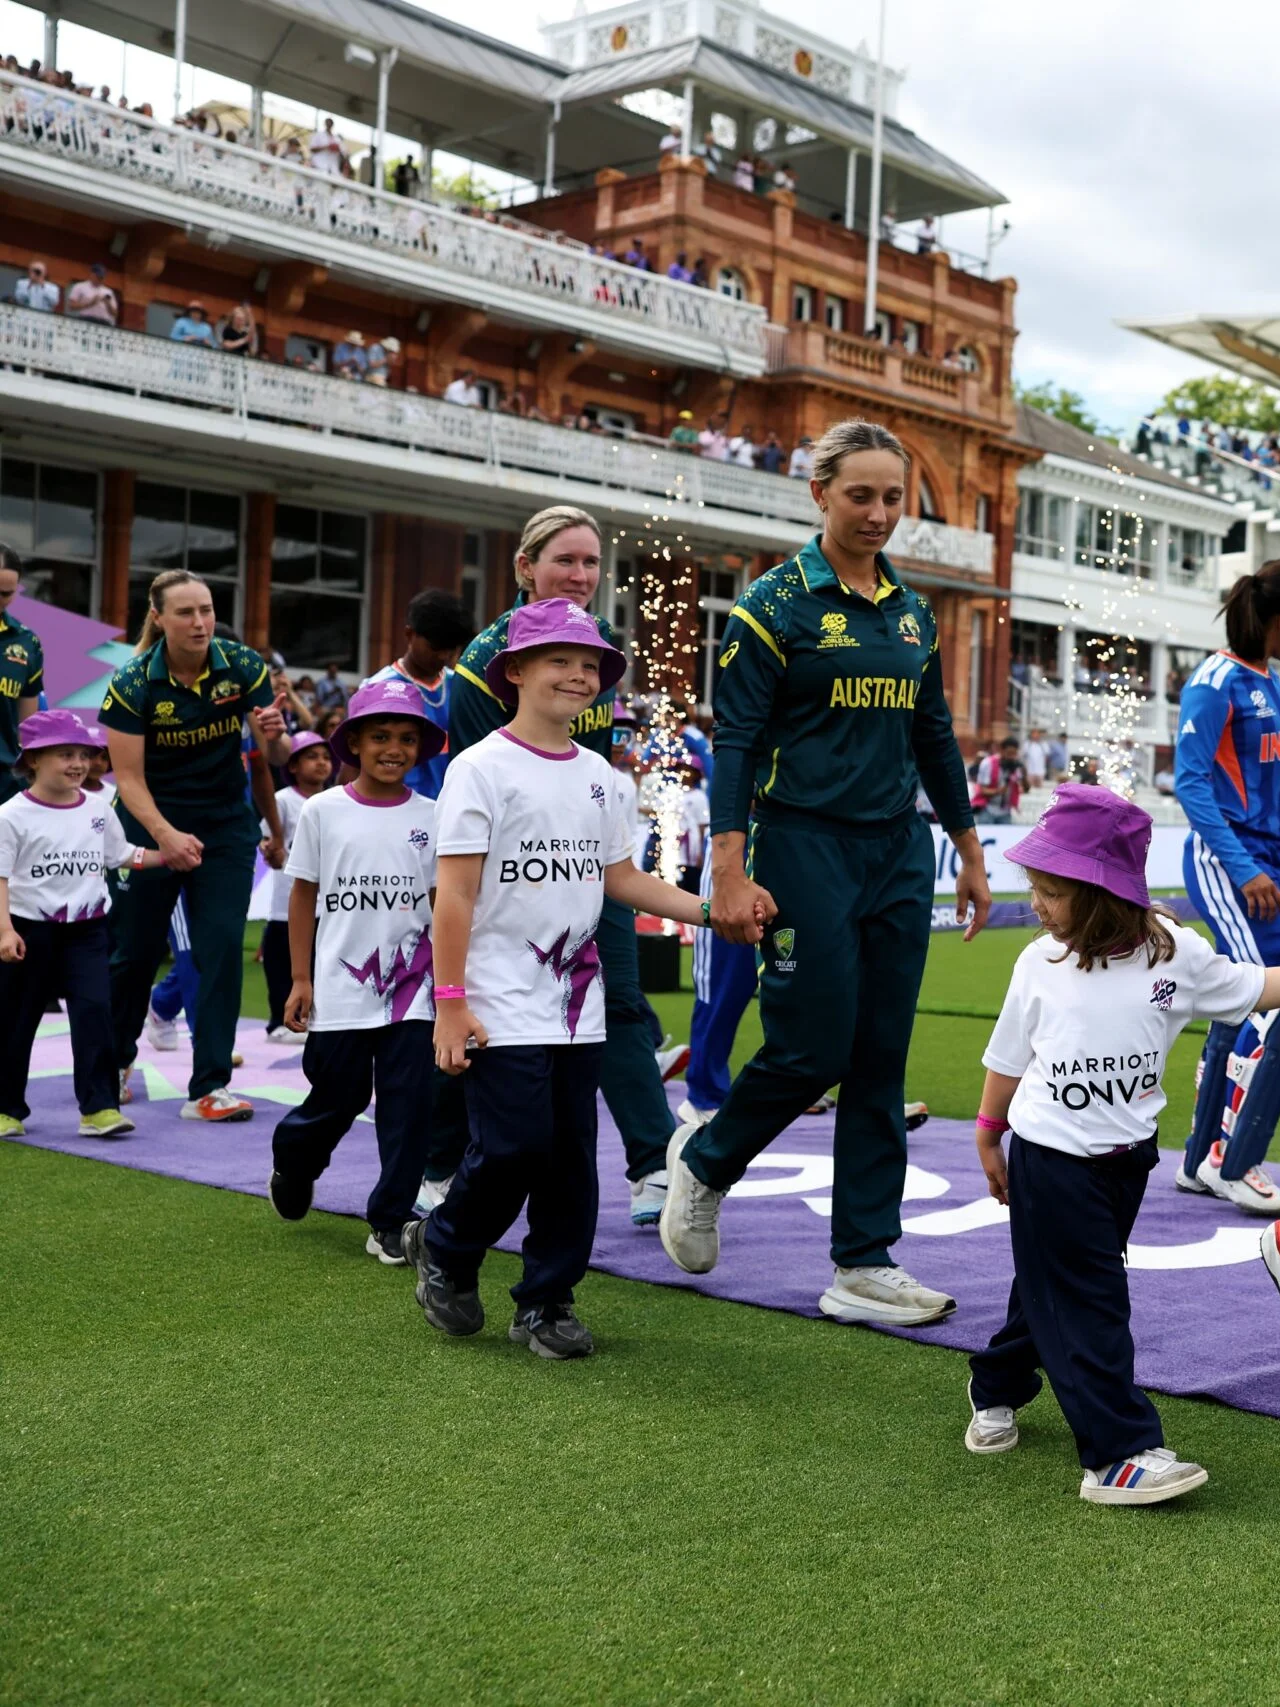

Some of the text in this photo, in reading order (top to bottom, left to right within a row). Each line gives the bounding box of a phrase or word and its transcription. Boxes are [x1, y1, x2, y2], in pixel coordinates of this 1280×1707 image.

[156, 715, 241, 747] AUSTRALIA
[43, 851, 101, 861] MARRIOTT
[520, 839, 600, 853] MARRIOTT
[338, 875, 415, 887] MARRIOTT
[500, 858, 604, 883] BONVOY
[325, 891, 427, 913] BONVOY
[1052, 1051, 1159, 1077] MARRIOTT
